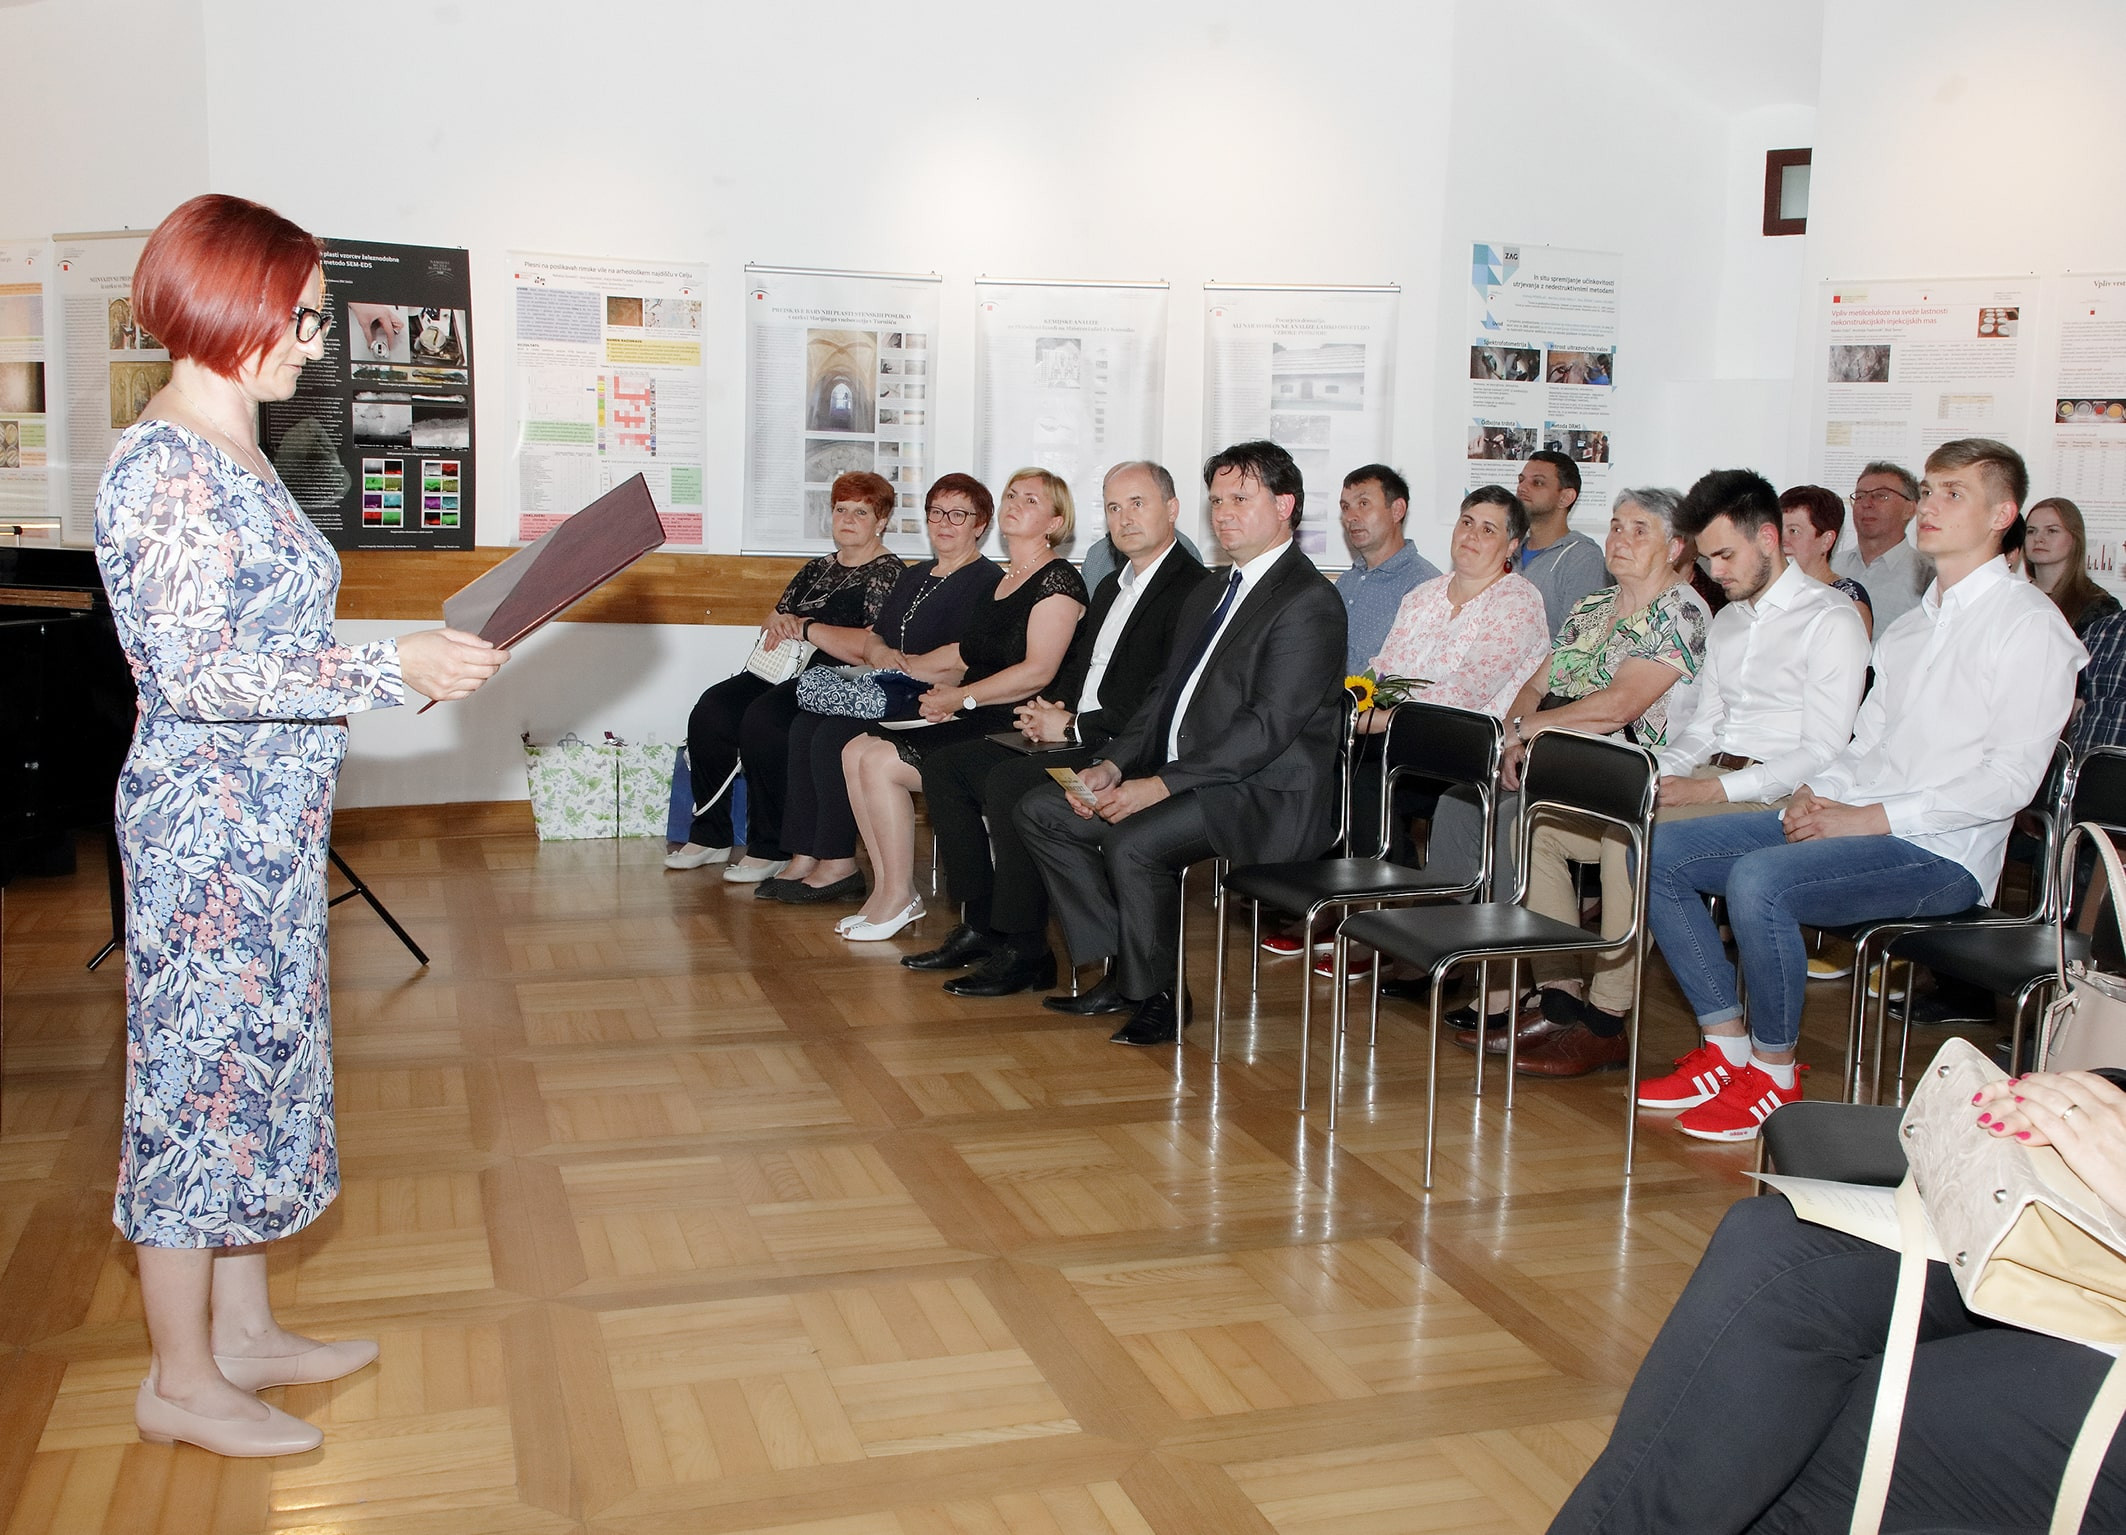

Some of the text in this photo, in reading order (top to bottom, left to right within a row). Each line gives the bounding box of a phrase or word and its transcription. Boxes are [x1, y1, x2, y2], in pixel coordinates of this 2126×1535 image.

[1504, 252, 1519, 261] ZAG
[1551, 275, 1581, 285] spremljanje
[1512, 281, 1540, 290] utrjevanja
[1545, 283, 1588, 292] nedestruktivnimi
[1589, 286, 1615, 294] metodami
[1831, 309, 1848, 317] Vpliv
[1849, 308, 1891, 316] metilceluloze
[1920, 307, 1949, 315] lastnosti
[1830, 318, 1886, 327] nekonstrukcijskih
[1887, 317, 1922, 326] injekcijskih
[1483, 339, 1527, 347] Spektrofotometrija
